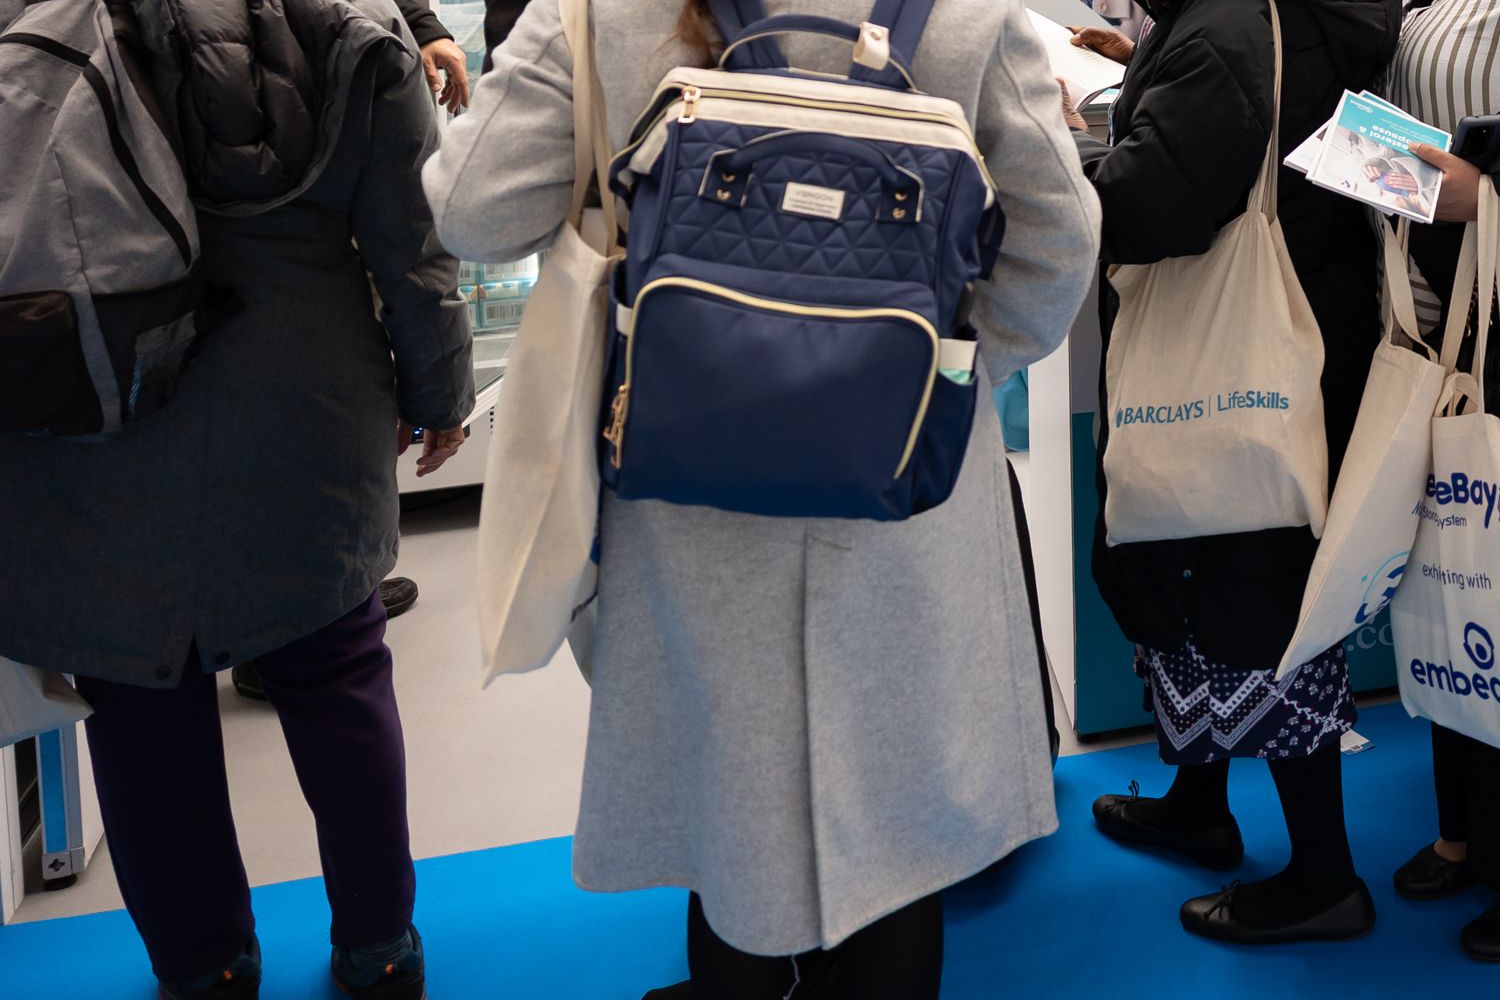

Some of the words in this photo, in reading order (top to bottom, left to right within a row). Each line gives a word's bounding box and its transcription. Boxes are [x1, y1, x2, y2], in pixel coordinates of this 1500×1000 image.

[1370, 131, 1408, 150] esterol
[1123, 400, 1204, 425] BARCLAYS
[1217, 390, 1289, 412] LifeSkills
[1466, 573, 1492, 590] with
